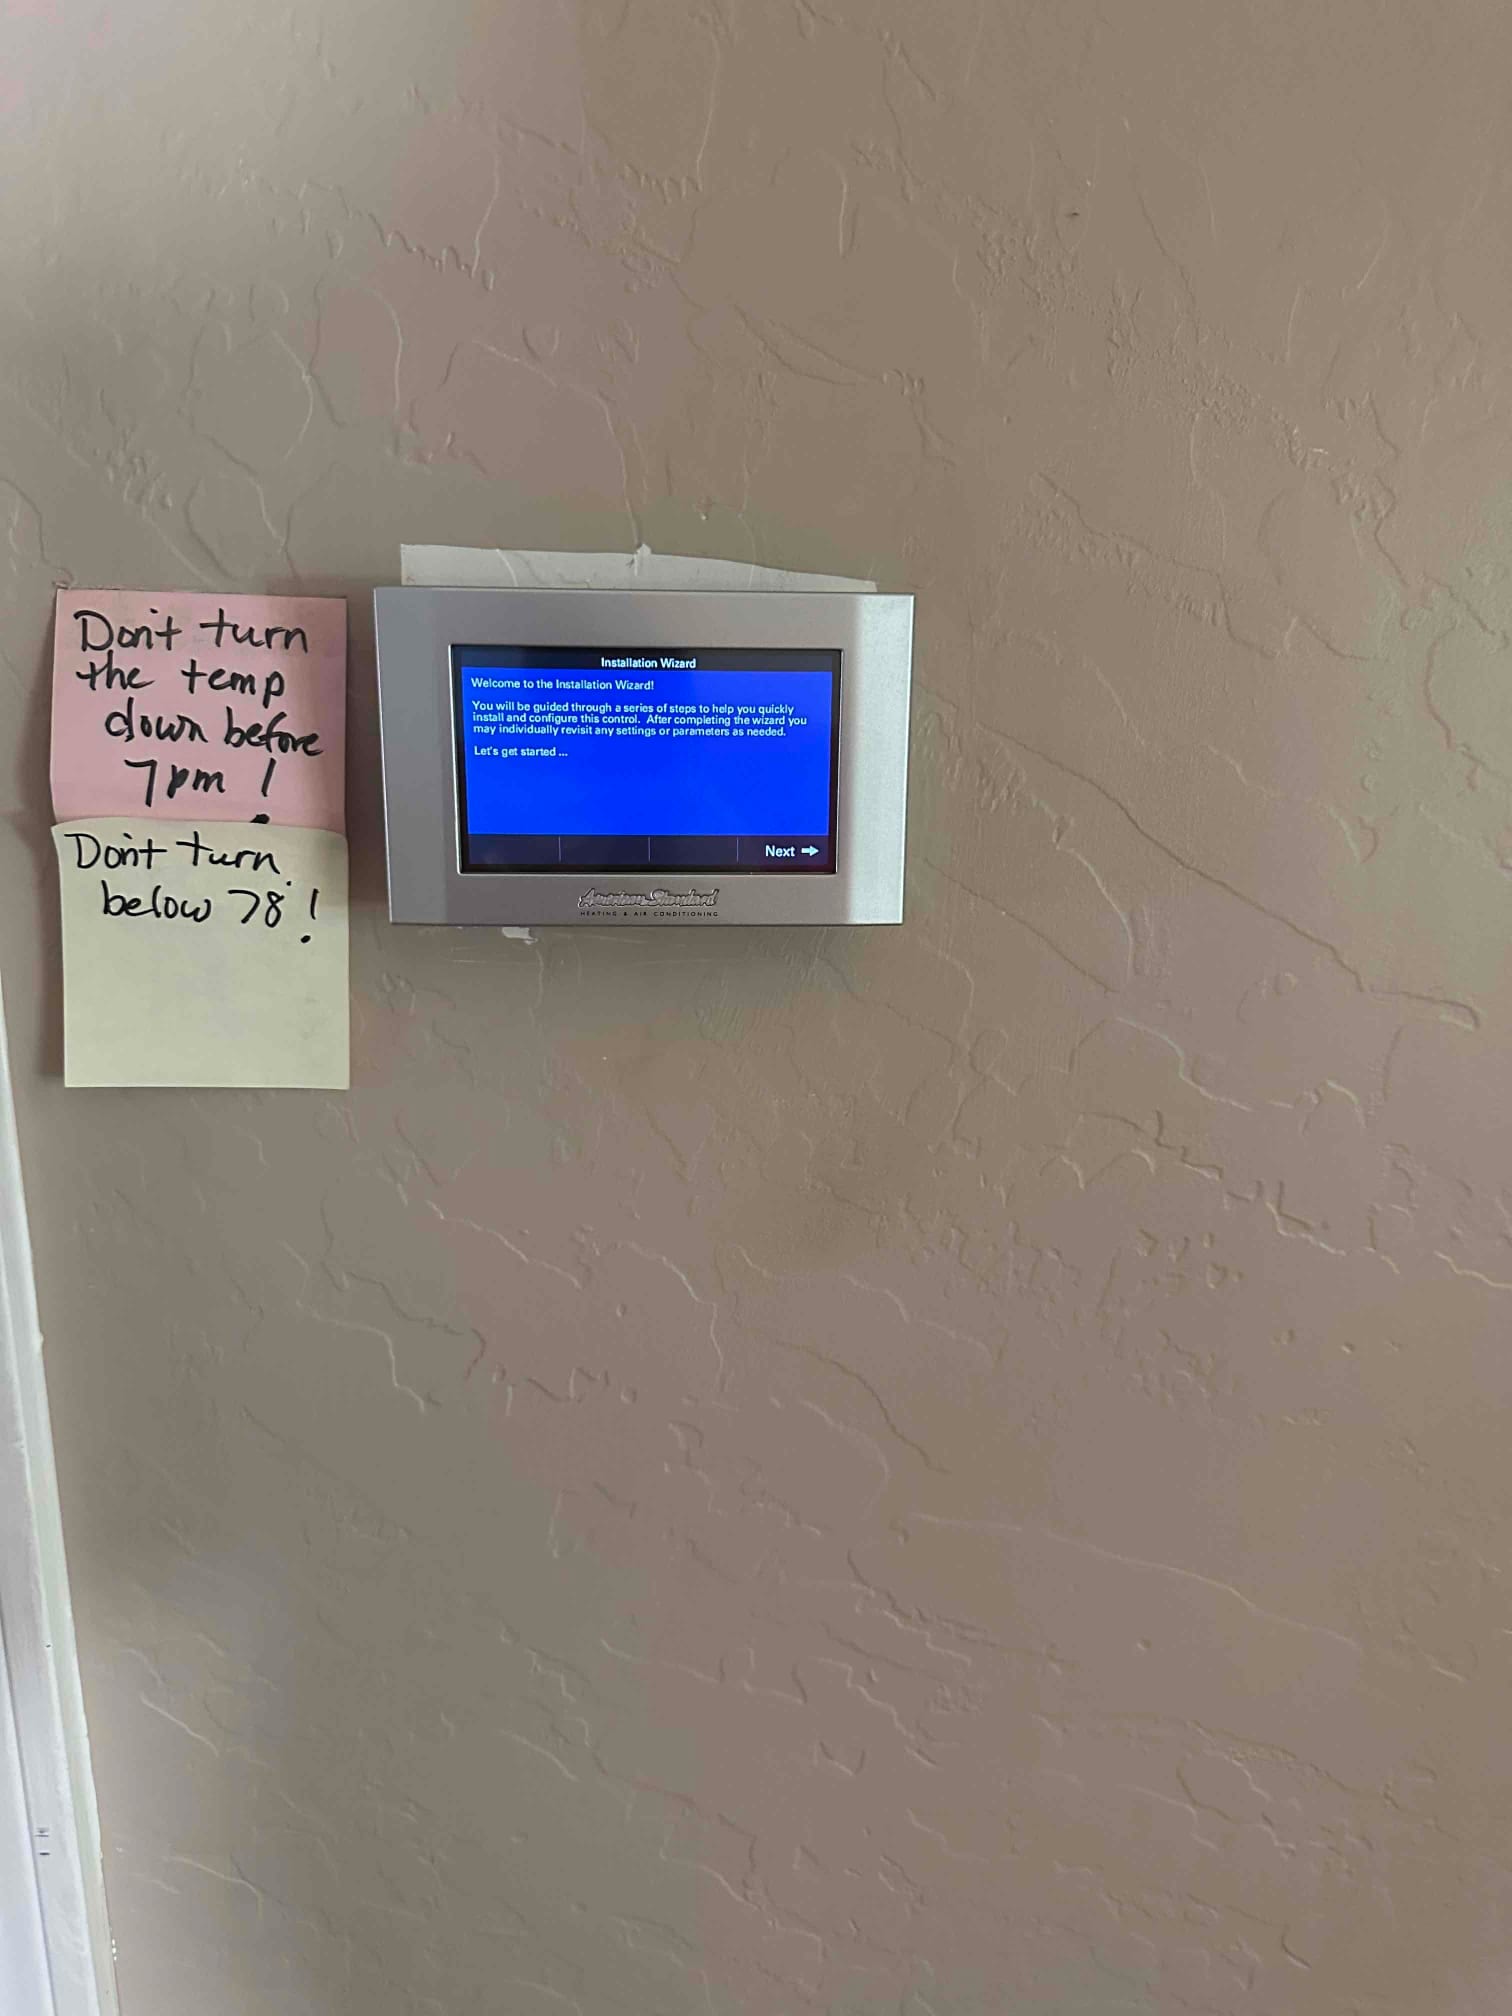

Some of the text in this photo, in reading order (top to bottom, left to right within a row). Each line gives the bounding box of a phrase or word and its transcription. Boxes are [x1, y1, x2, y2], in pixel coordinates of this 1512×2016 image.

[74, 608, 308, 653] Don't turn
[601, 657, 696, 669] Installation Wizard
[76, 650, 284, 708] the temp
[471, 677, 654, 690] Welcome to the Installation Wizard!
[472, 701, 794, 716] You will be guided through a series of steps to help you quickly
[104, 696, 324, 756] down before
[473, 713, 807, 727] install and configure this control. After completing the wizard you
[473, 726, 496, 735] may
[499, 724, 558, 736] individually
[561, 725, 593, 735] revisit
[595, 728, 614, 736] any
[616, 726, 656, 737] settings
[672, 727, 730, 737] parameters
[747, 727, 786, 737] needed.
[474, 746, 498, 756] Let's
[502, 747, 518, 758] get
[520, 747, 556, 756] started
[64, 830, 280, 874] Don't turn
[765, 845, 795, 857] Next
[101, 879, 212, 922] below
[651, 889, 719, 907] Standard
